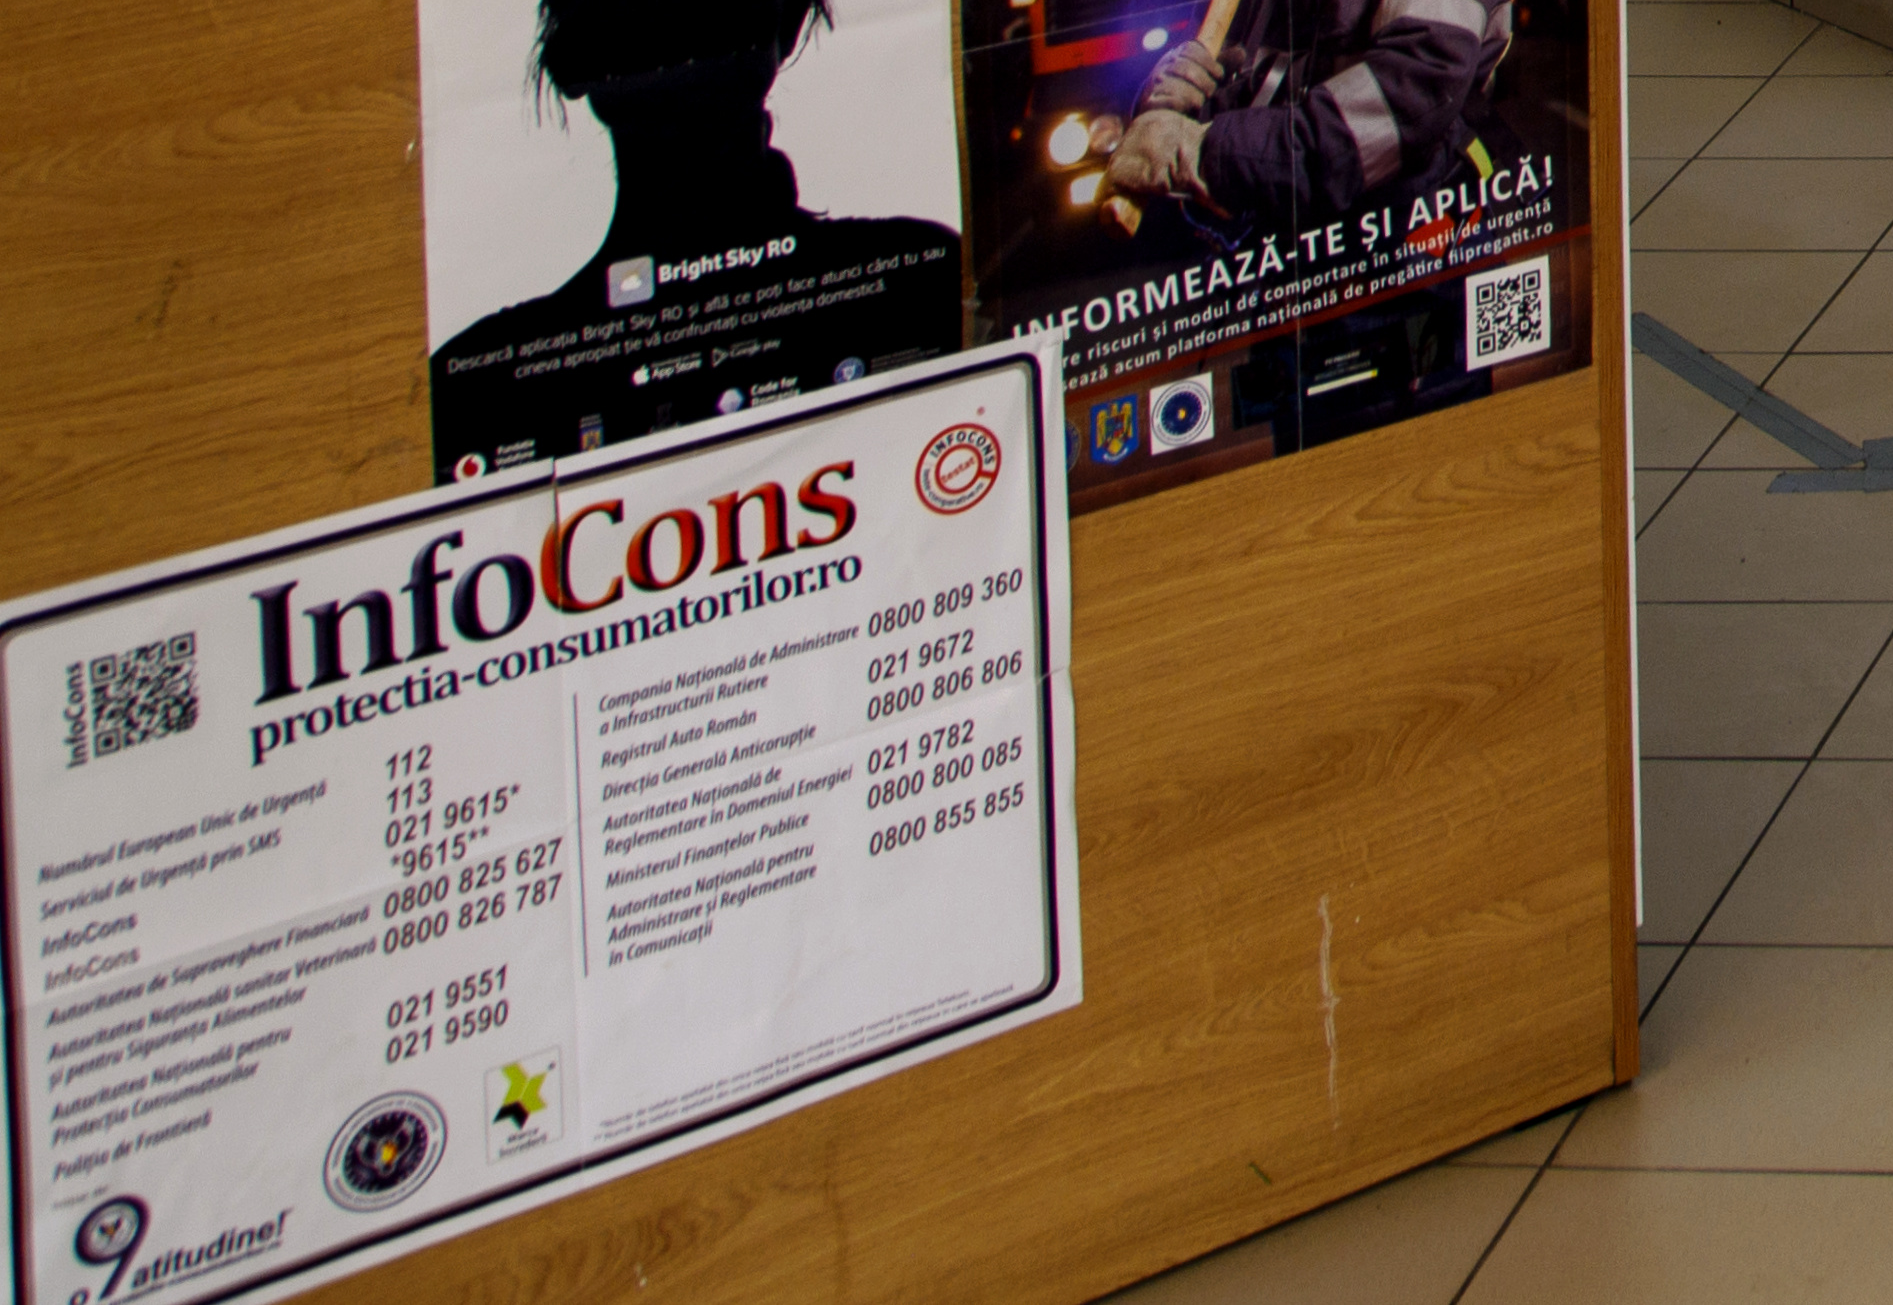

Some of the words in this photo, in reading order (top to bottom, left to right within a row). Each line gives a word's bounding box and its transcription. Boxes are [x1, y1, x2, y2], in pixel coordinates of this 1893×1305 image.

[1360, 207, 1392, 252] ȘI
[1408, 154, 1553, 230] APLICĂ!
[657, 252, 724, 283] Bright
[725, 246, 764, 269] Sky
[767, 235, 796, 260] RO
[1087, 327, 1147, 362] riscuri
[1153, 320, 1168, 341] și
[1174, 300, 1230, 333] modul
[1236, 292, 1258, 311] de
[1264, 260, 1368, 302] comportare
[1373, 250, 1389, 268] în
[1395, 228, 1455, 260] situații
[1462, 220, 1481, 239] de
[1487, 198, 1552, 231] urgență
[1115, 351, 1161, 374] acum
[1168, 320, 1251, 360] platforma
[1257, 285, 1338, 327] națională
[1344, 283, 1364, 300] de
[1370, 257, 1443, 294] pregătire
[1449, 222, 1553, 266] fiipregatit.ro
[929, 430, 995, 465] INFOCONS
[250, 458, 859, 707] InfoCons
[866, 598, 925, 640] 0800
[932, 583, 974, 620] 809
[981, 567, 1024, 604] 360
[247, 552, 863, 767] protectia-consumatorilor.ro
[866, 648, 909, 685] 021
[917, 629, 976, 669] 9672
[866, 682, 925, 723] 0800
[930, 664, 974, 702] 806
[981, 650, 1024, 685] 806
[65, 660, 89, 770] InfoCons
[601, 734, 668, 769] Registrul
[669, 727, 704, 749] Auto
[706, 709, 757, 738] Român
[866, 739, 909, 776] 021
[917, 718, 976, 760] 9782
[384, 744, 433, 781] 112
[385, 778, 434, 815] 113
[866, 768, 925, 810] 0800
[930, 752, 974, 789] 800
[981, 735, 1024, 772] 085
[383, 810, 433, 849] 021
[606, 851, 681, 889] Ministerul
[683, 831, 757, 866] Finanțelor
[759, 812, 810, 841] Publice
[868, 815, 927, 857] 0800
[933, 798, 978, 835] 855
[982, 781, 1027, 818] 855
[382, 875, 450, 921] 0800
[458, 860, 507, 895] 825
[515, 838, 564, 878] 627
[382, 910, 450, 957] 0800
[458, 894, 507, 931] 826
[516, 873, 564, 913] 787
[384, 1026, 434, 1066] 021
[443, 1000, 510, 1045] 9590
[386, 990, 434, 1031] 021
[444, 964, 510, 1010] 9551
